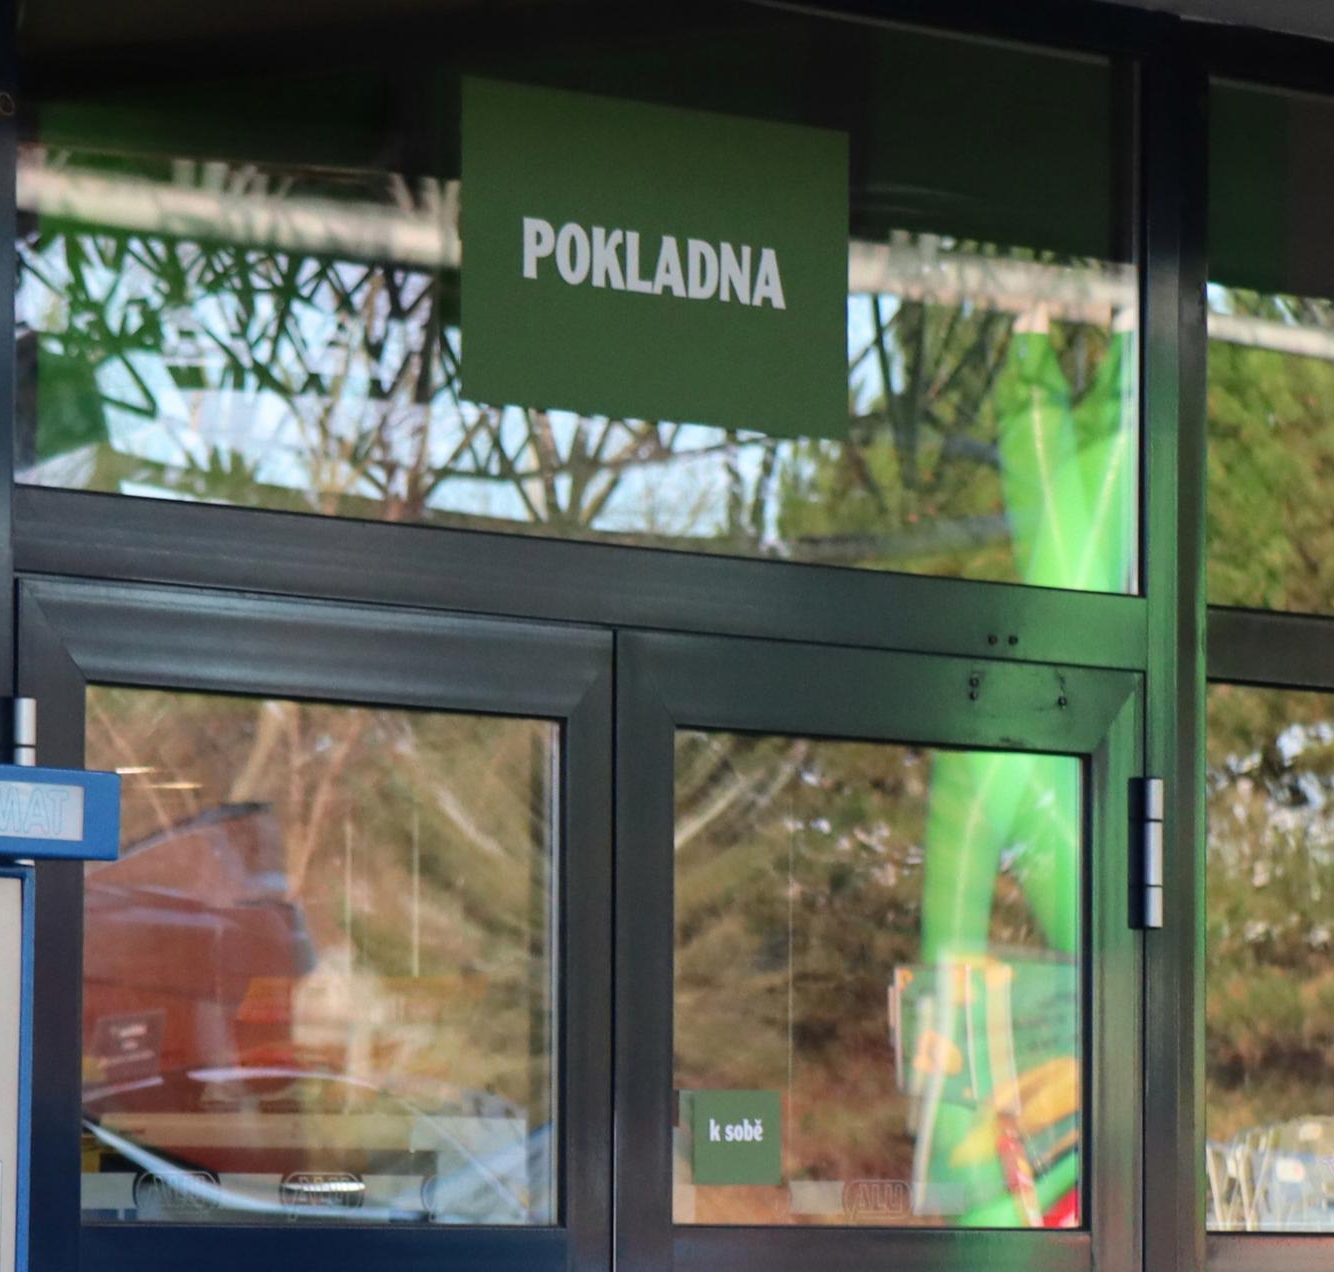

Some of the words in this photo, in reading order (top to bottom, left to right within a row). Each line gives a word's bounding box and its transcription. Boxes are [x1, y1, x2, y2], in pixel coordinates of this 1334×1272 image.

[523, 216, 786, 310] POKLADNA
[709, 1118, 721, 1143] k
[724, 1118, 764, 1143] sobě
